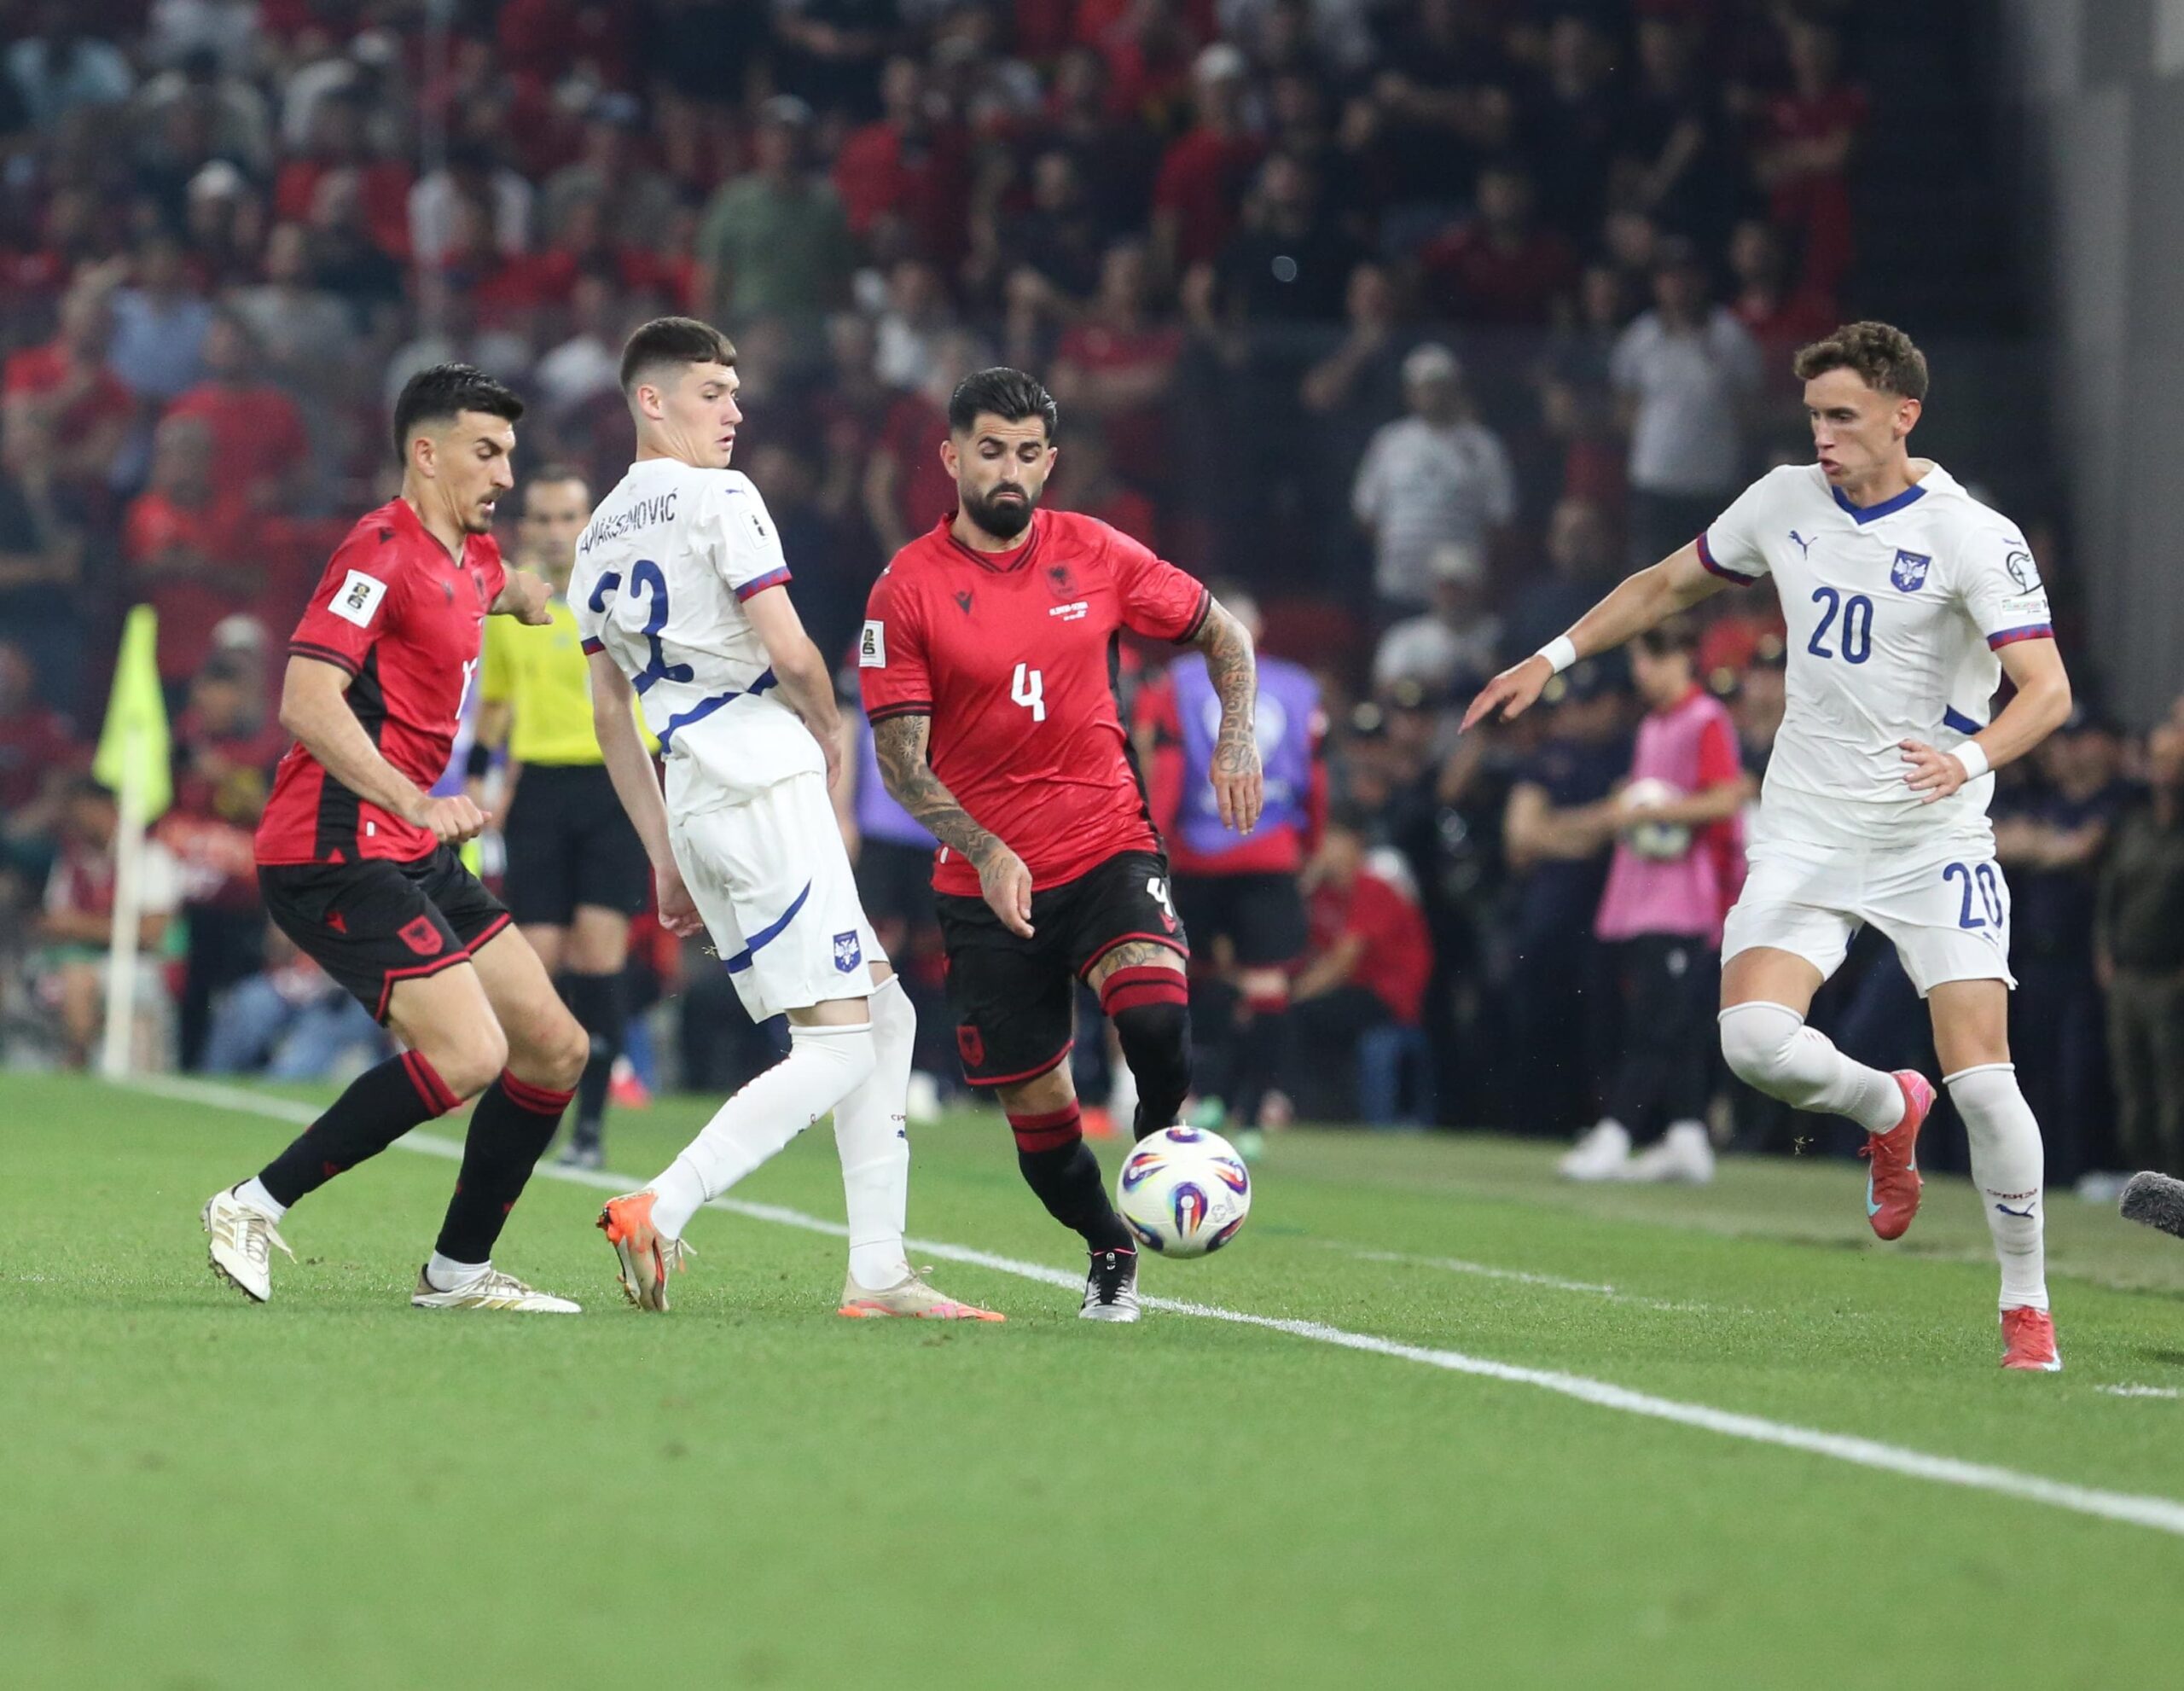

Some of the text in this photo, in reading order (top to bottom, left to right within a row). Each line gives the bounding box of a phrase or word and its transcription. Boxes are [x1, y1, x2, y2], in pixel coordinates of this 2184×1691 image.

[1808, 586, 1873, 664] 20
[1011, 662, 1046, 722] 4
[1147, 877, 1174, 918] 4
[1943, 862, 2003, 929] 20
